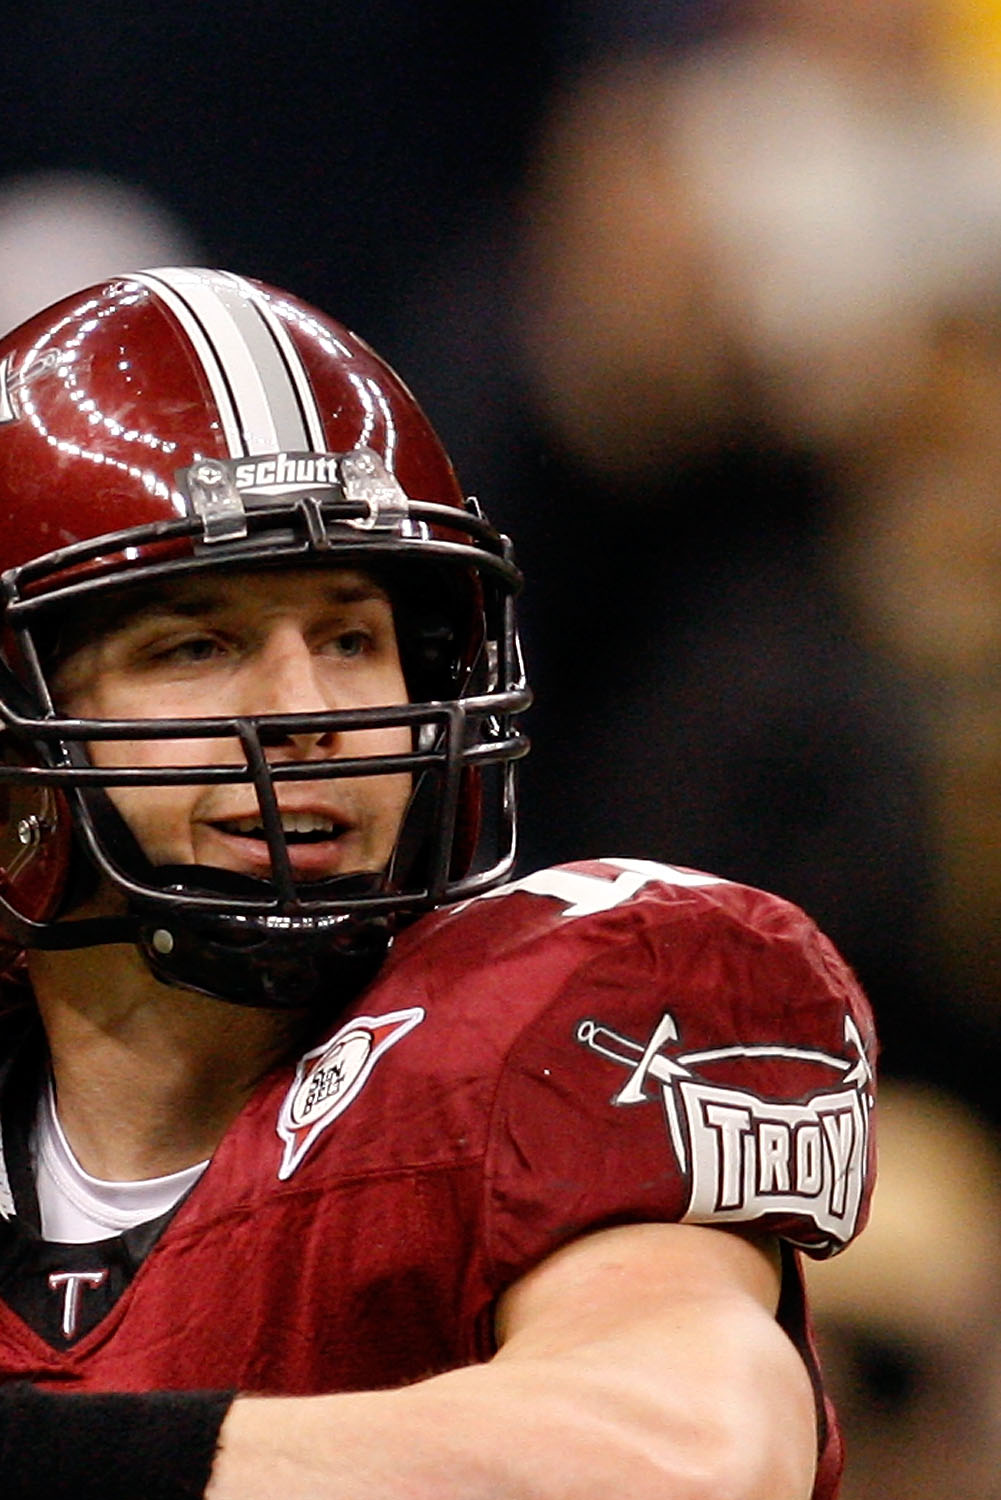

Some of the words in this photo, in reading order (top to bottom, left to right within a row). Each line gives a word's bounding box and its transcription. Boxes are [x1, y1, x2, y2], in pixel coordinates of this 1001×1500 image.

[235, 453, 339, 486] schutt
[703, 1101, 854, 1220] TROY
[48, 1269, 106, 1337] T
